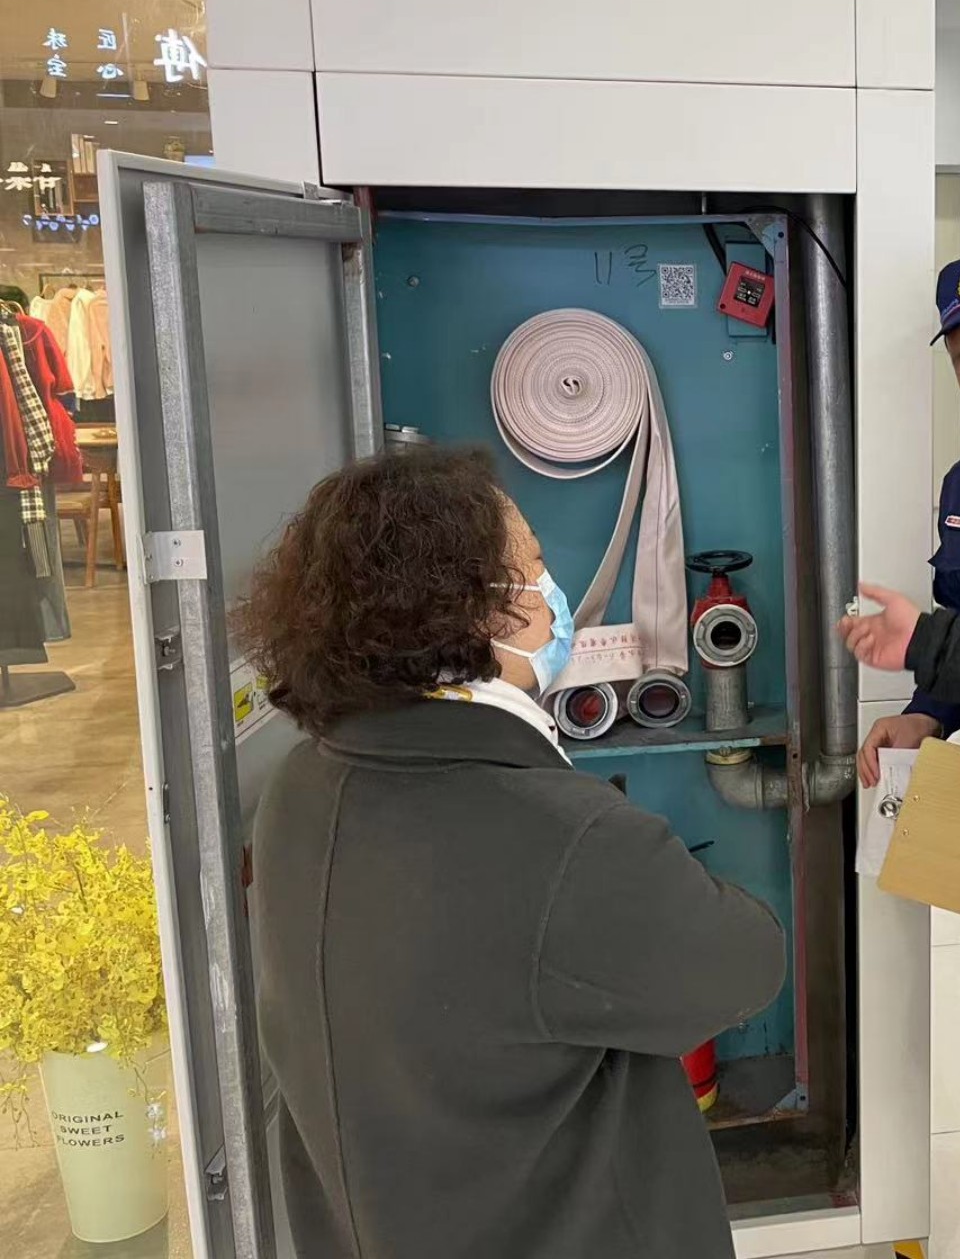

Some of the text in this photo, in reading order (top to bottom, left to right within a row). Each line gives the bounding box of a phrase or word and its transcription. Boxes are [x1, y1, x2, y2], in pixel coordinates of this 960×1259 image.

[51, 1111, 124, 1123] ORIGINAL
[60, 1124, 112, 1135] SWEET
[56, 1134, 125, 1147] FLOWERS
